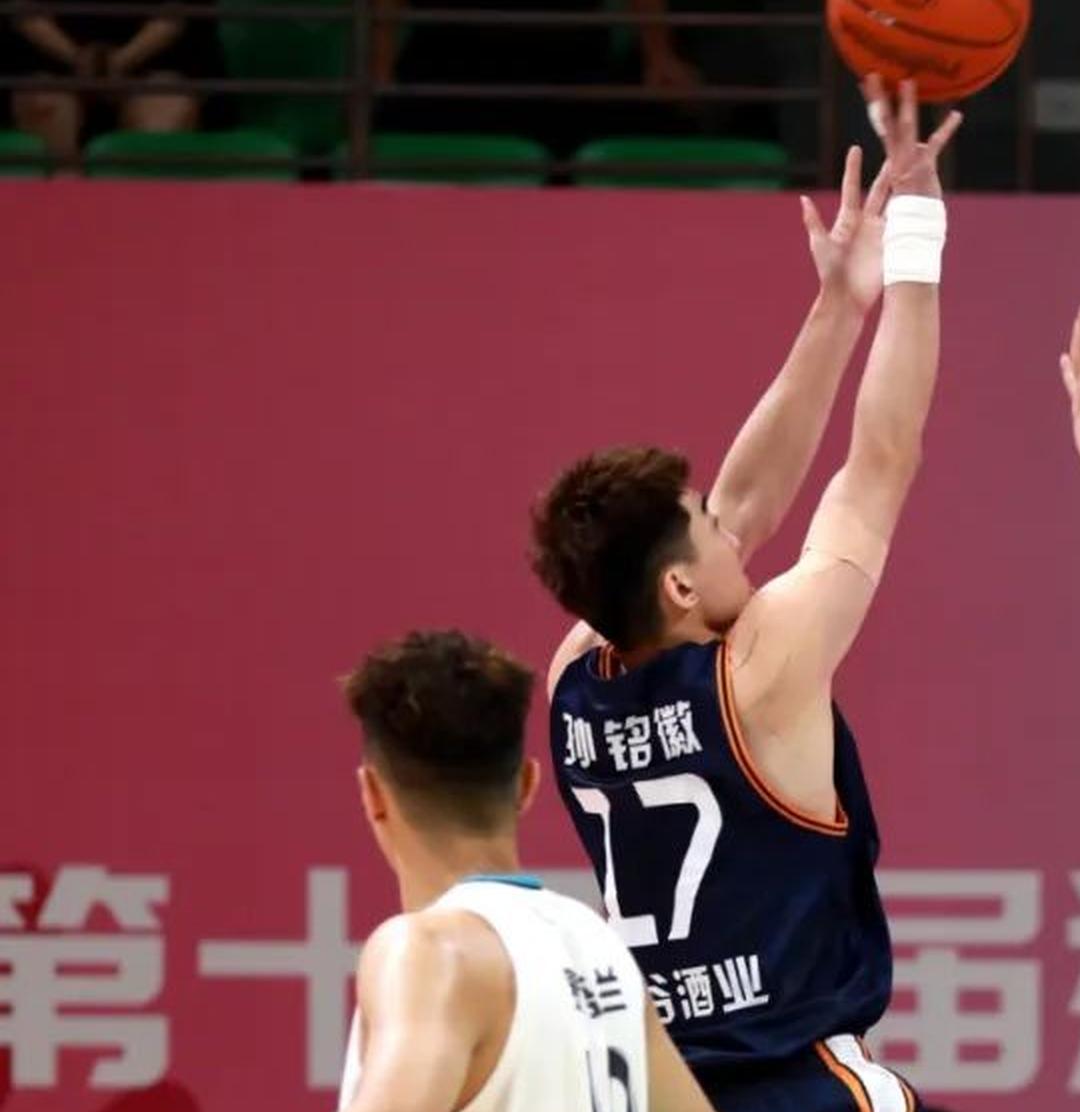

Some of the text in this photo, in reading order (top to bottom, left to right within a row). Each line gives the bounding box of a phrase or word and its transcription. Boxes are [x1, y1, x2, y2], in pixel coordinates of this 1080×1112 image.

[562, 701, 703, 771] 孙铭徽
[572, 772, 723, 948] 17
